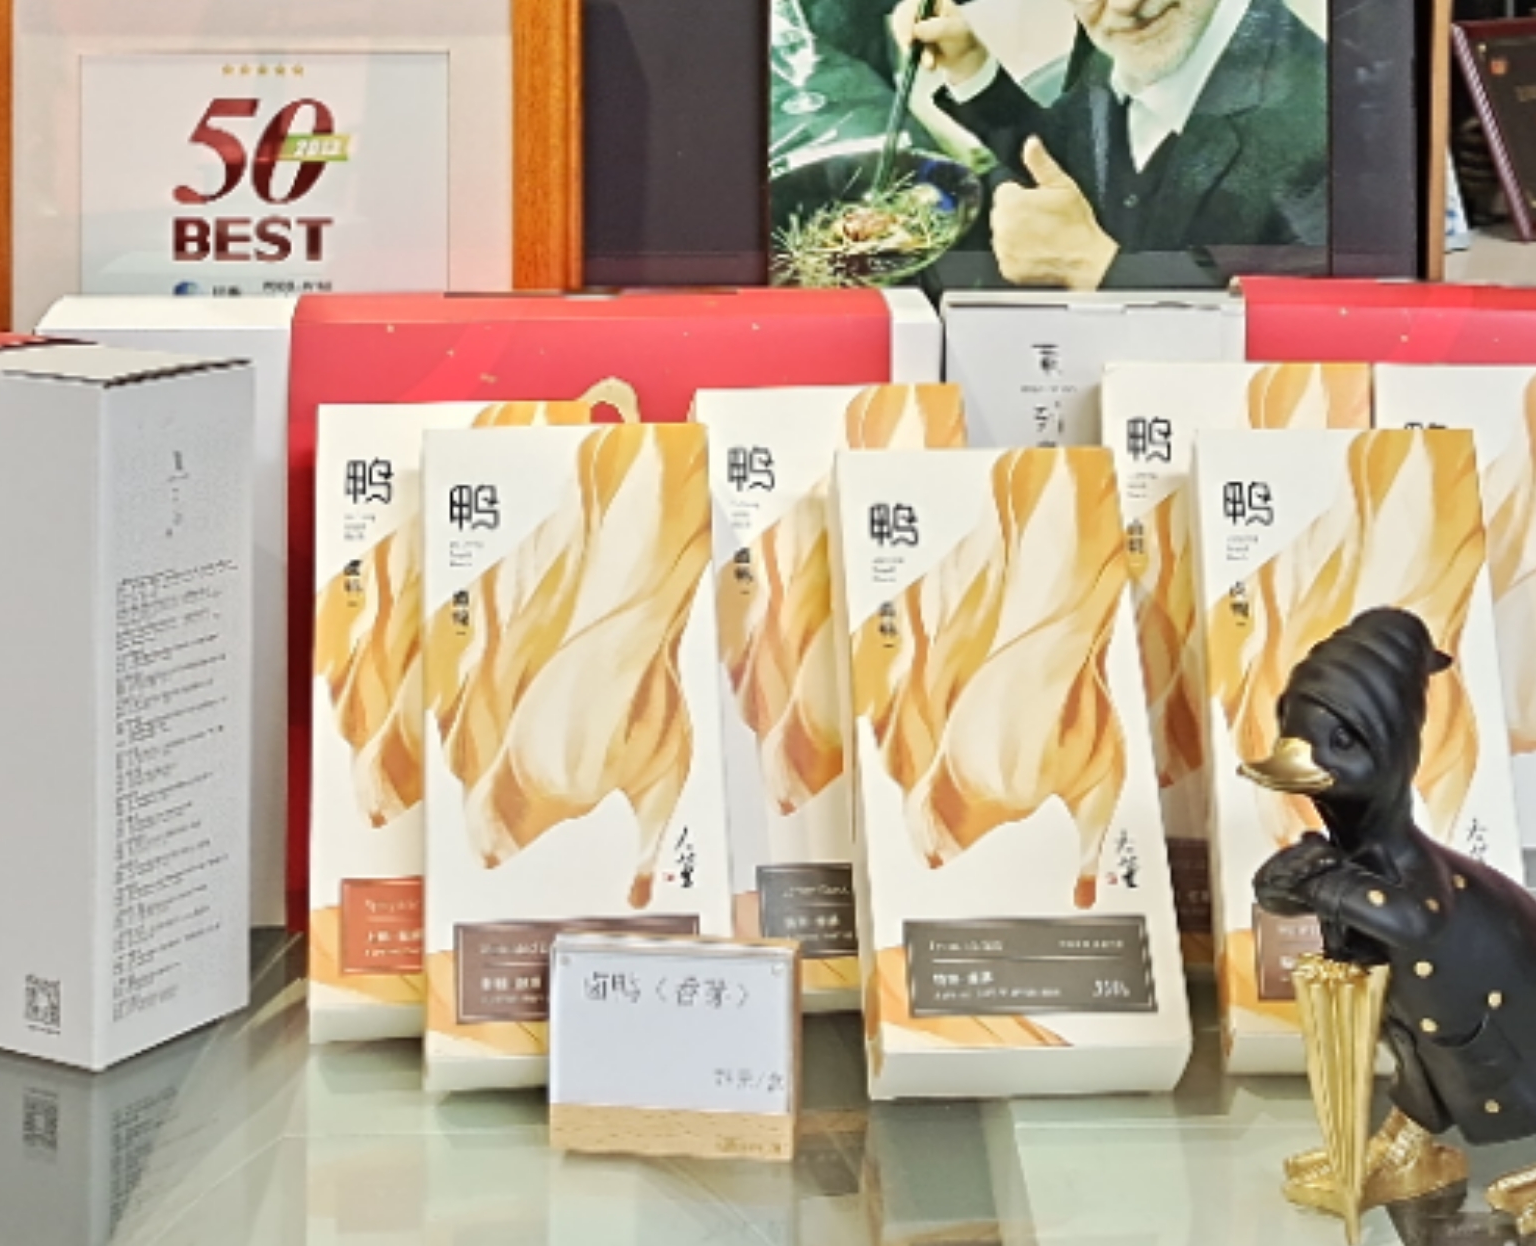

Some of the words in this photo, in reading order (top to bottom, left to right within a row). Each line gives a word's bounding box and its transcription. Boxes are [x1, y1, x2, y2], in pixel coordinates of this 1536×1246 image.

[172, 96, 336, 205] 50
[172, 216, 333, 262] BEST
[1126, 415, 1173, 463] 鸭
[343, 458, 394, 505] 鸭
[727, 445, 776, 492] 鸭
[448, 483, 502, 532] 鸭
[868, 502, 920, 548] 鸭
[1221, 481, 1275, 526] 鸭
